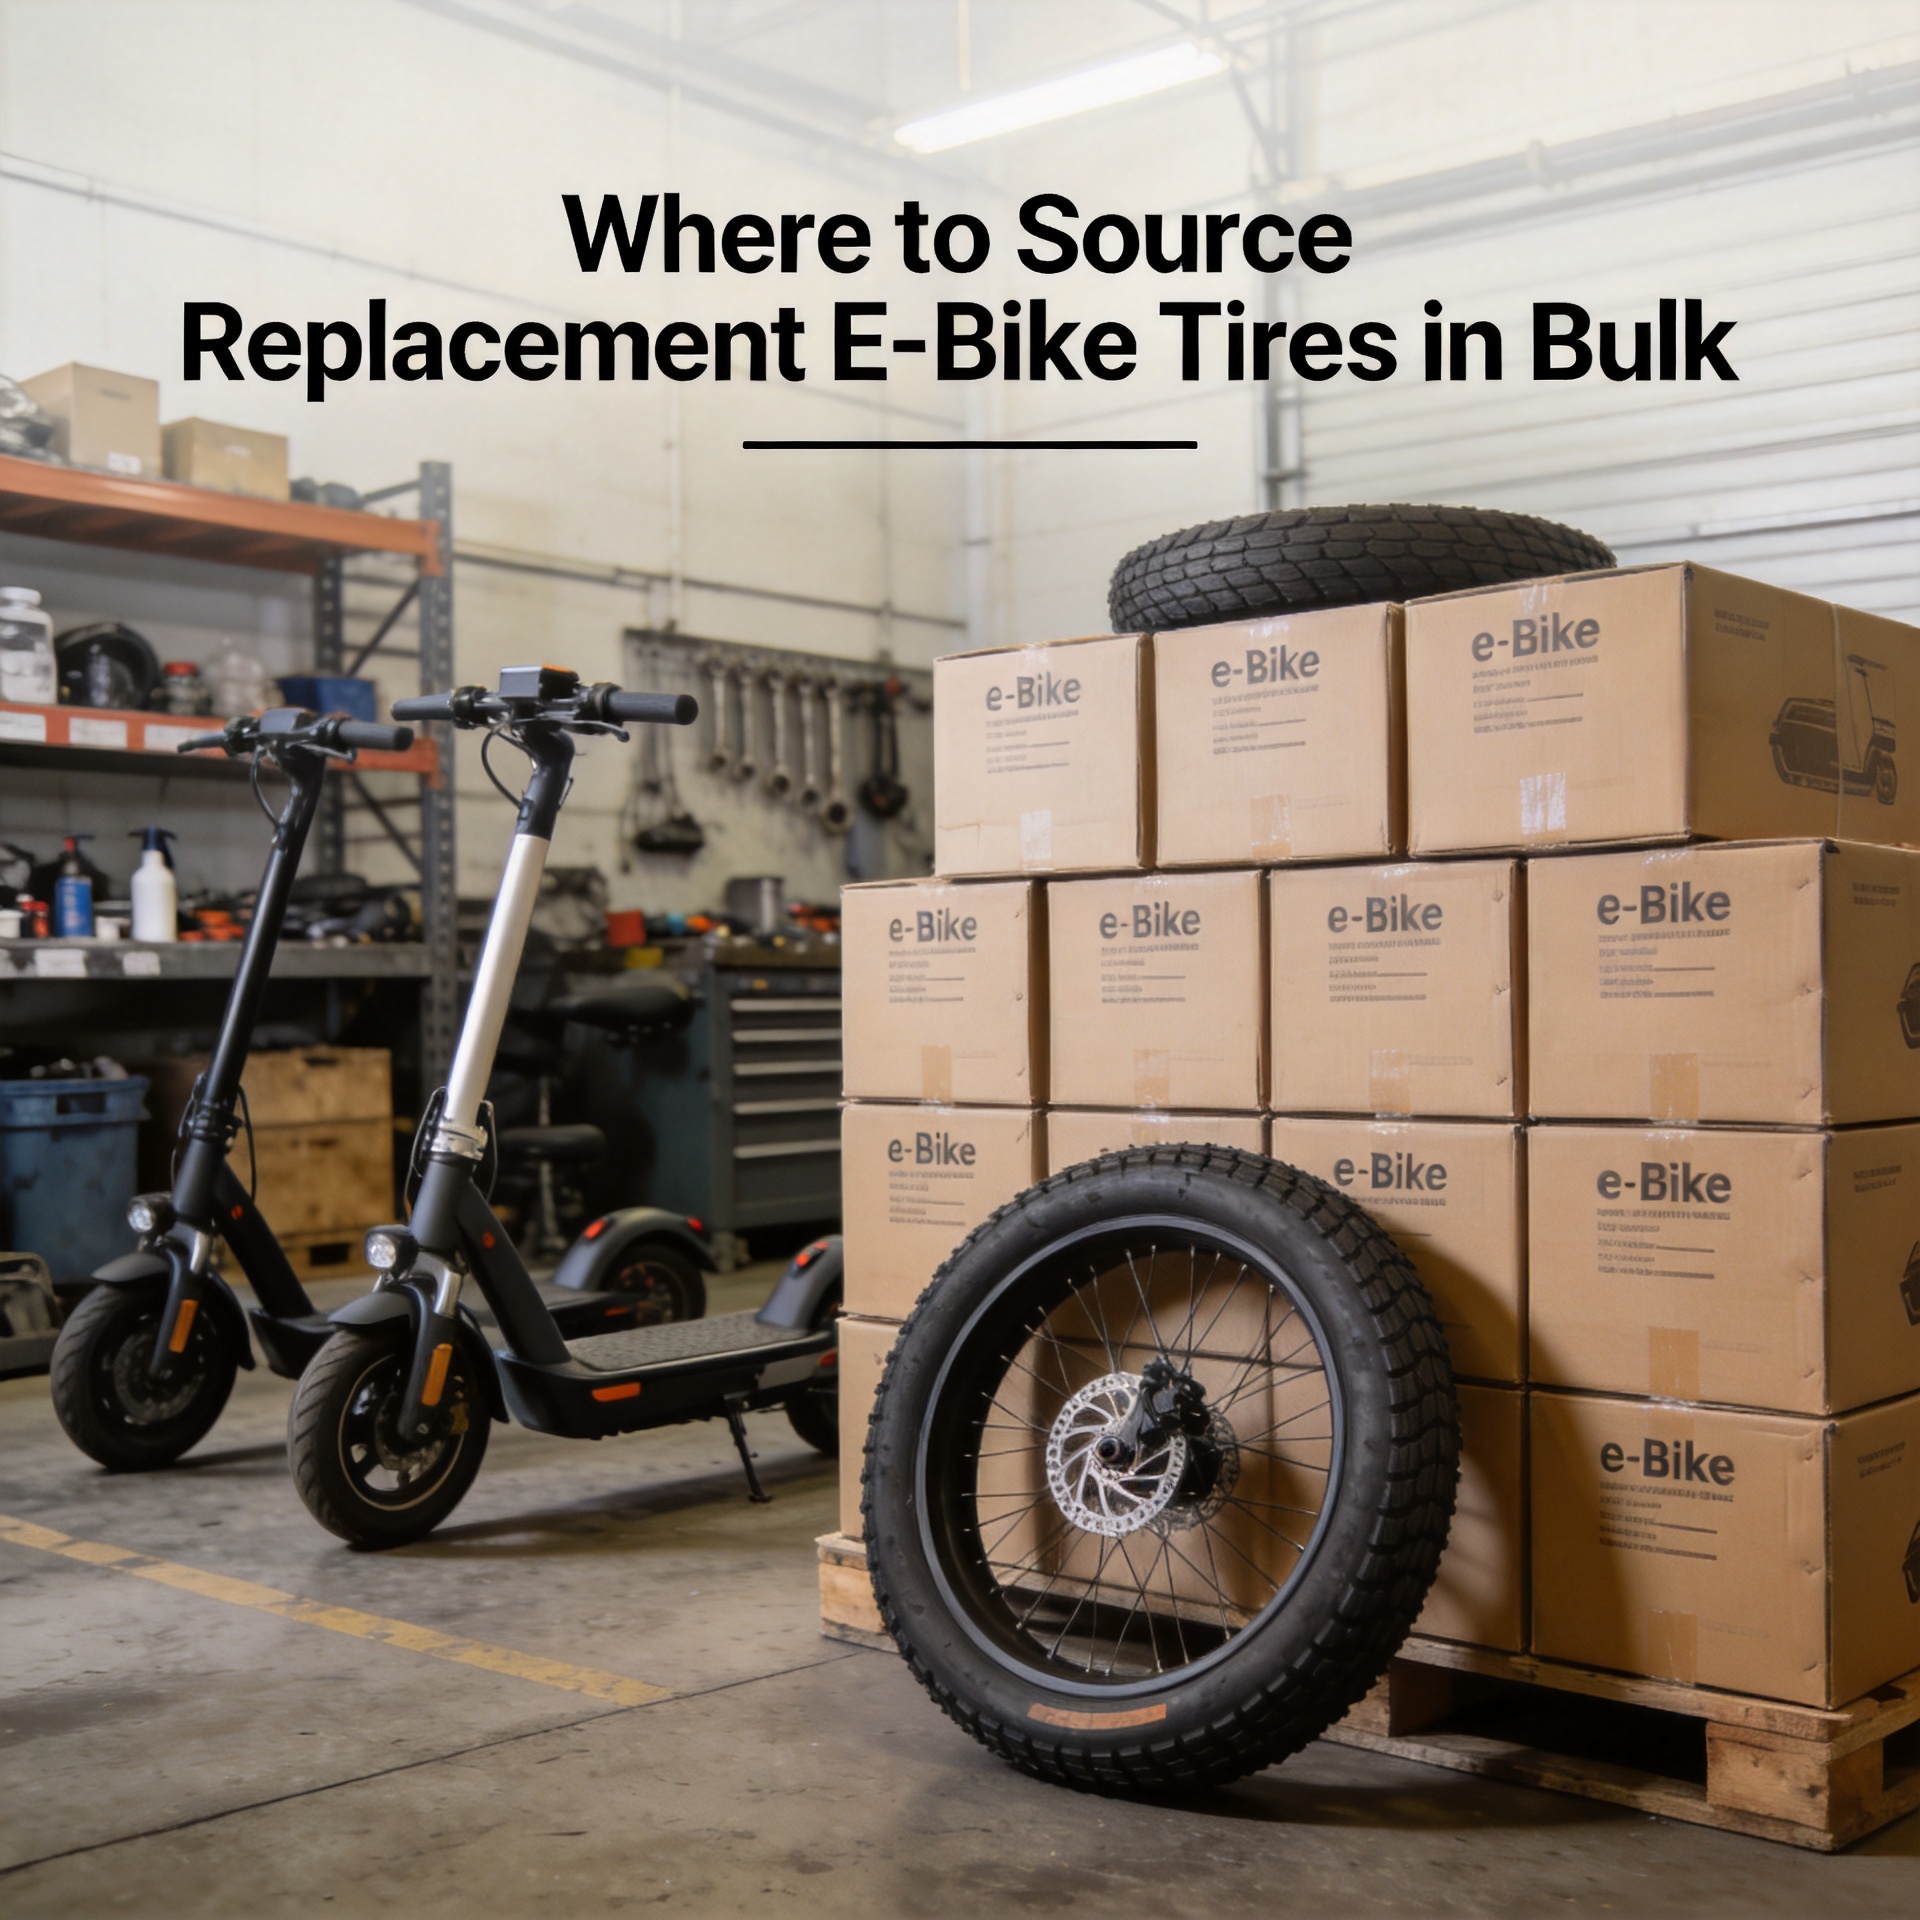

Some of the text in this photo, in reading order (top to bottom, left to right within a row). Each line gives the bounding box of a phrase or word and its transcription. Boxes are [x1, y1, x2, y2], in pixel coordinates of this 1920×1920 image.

[1471, 612, 1601, 663] e-Bike
[1212, 644, 1320, 688] e-Bike
[986, 672, 1082, 712] e-Bike
[1099, 902, 1201, 940] e-Bike
[1327, 894, 1444, 933] e-Bike
[1597, 882, 1731, 926] e-Bike
[889, 908, 977, 943] e-Bike
[887, 1132, 977, 1166] e-Bike
[1333, 1152, 1448, 1191] e-Bike
[1597, 1161, 1732, 1204] e-Bike
[1600, 1438, 1735, 1487] e-Bike
